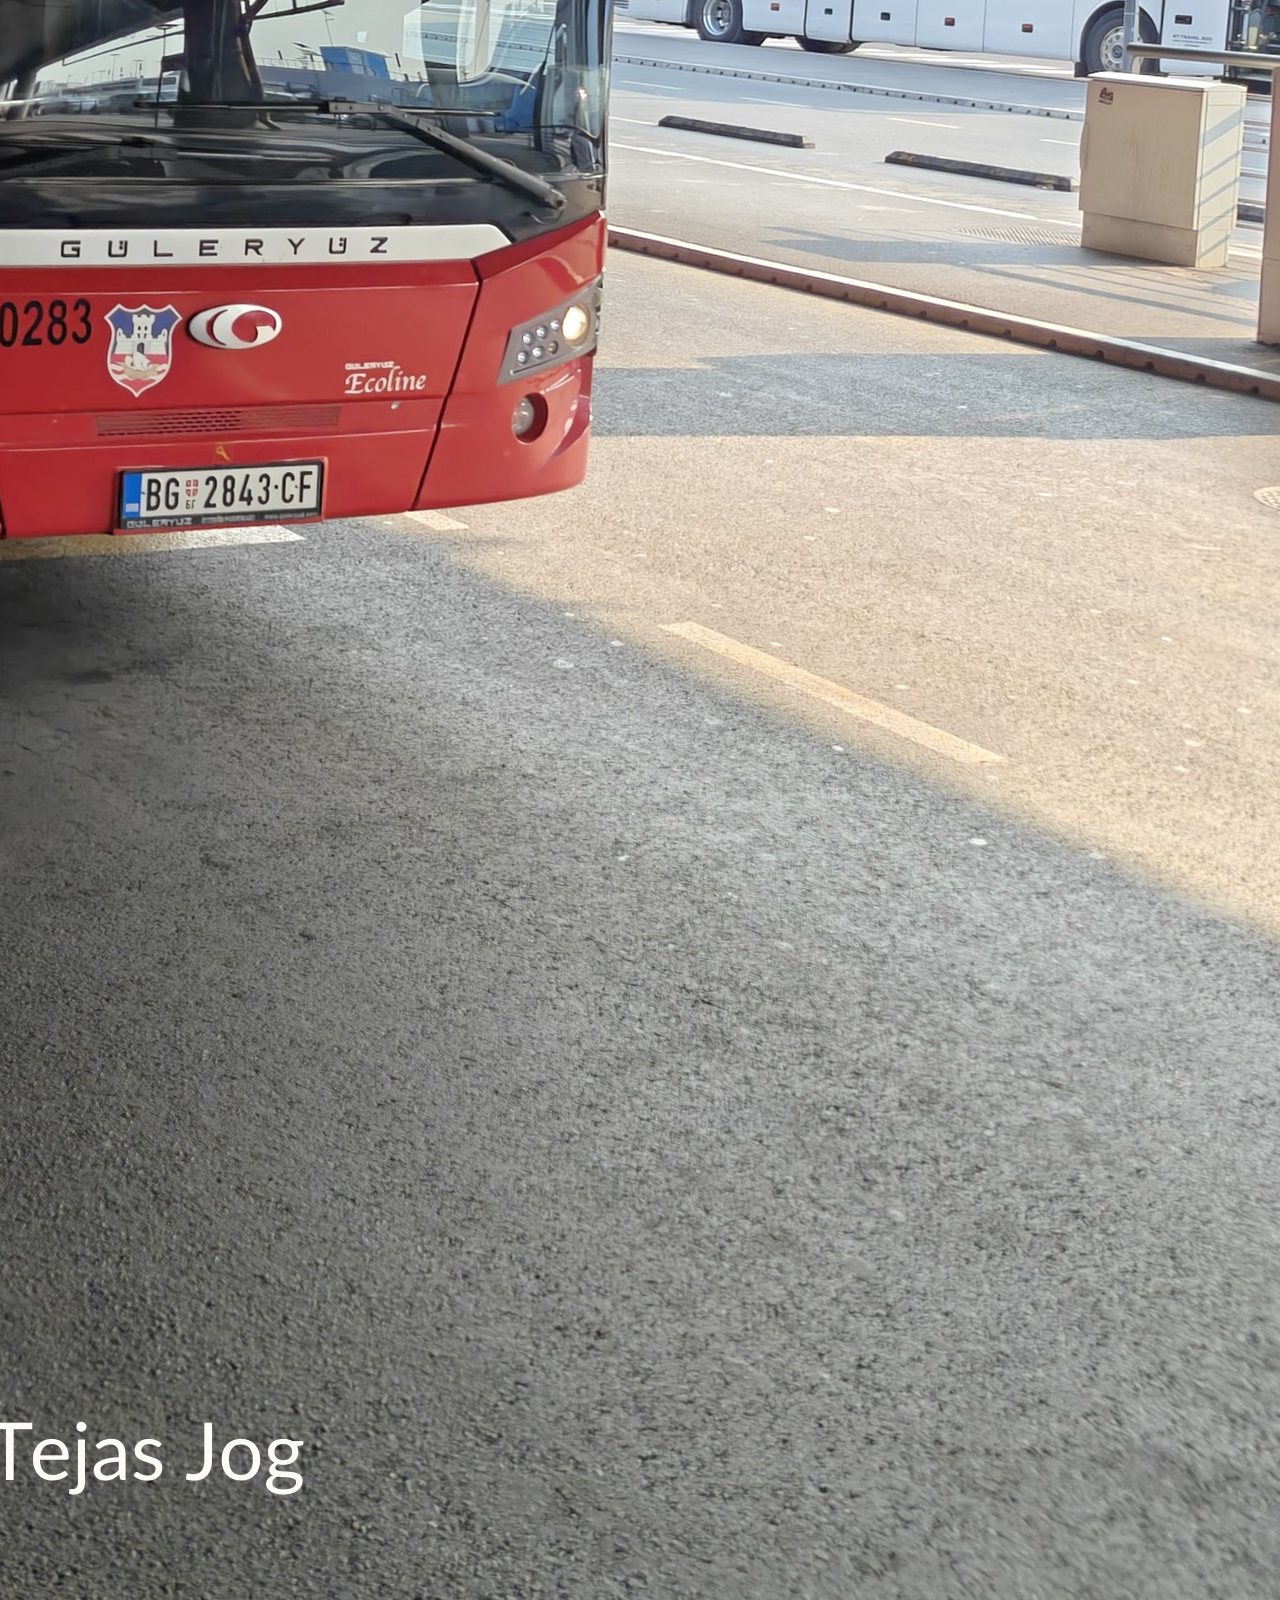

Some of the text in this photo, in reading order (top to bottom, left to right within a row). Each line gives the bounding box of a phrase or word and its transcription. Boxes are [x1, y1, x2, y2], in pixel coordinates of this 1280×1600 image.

[60, 236, 389, 258] GÜLERYÜZ
[343, 365, 427, 395] Ecoline
[146, 477, 180, 511] BG
